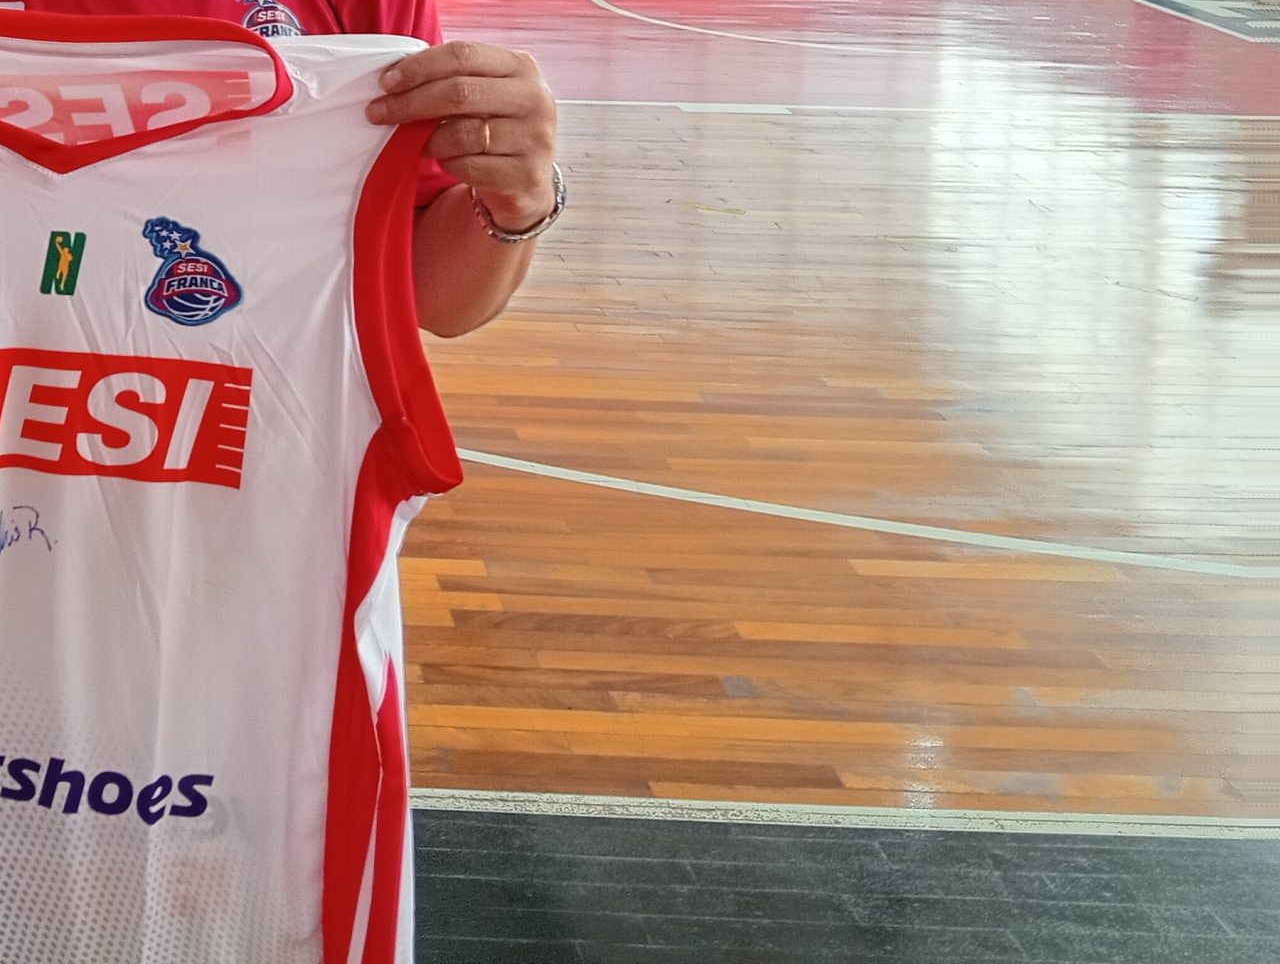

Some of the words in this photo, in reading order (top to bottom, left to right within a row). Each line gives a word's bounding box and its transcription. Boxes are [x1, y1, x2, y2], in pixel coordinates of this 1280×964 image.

[257, 10, 286, 22] SESI
[176, 262, 209, 274] SESI
[164, 276, 227, 293] FRANCA
